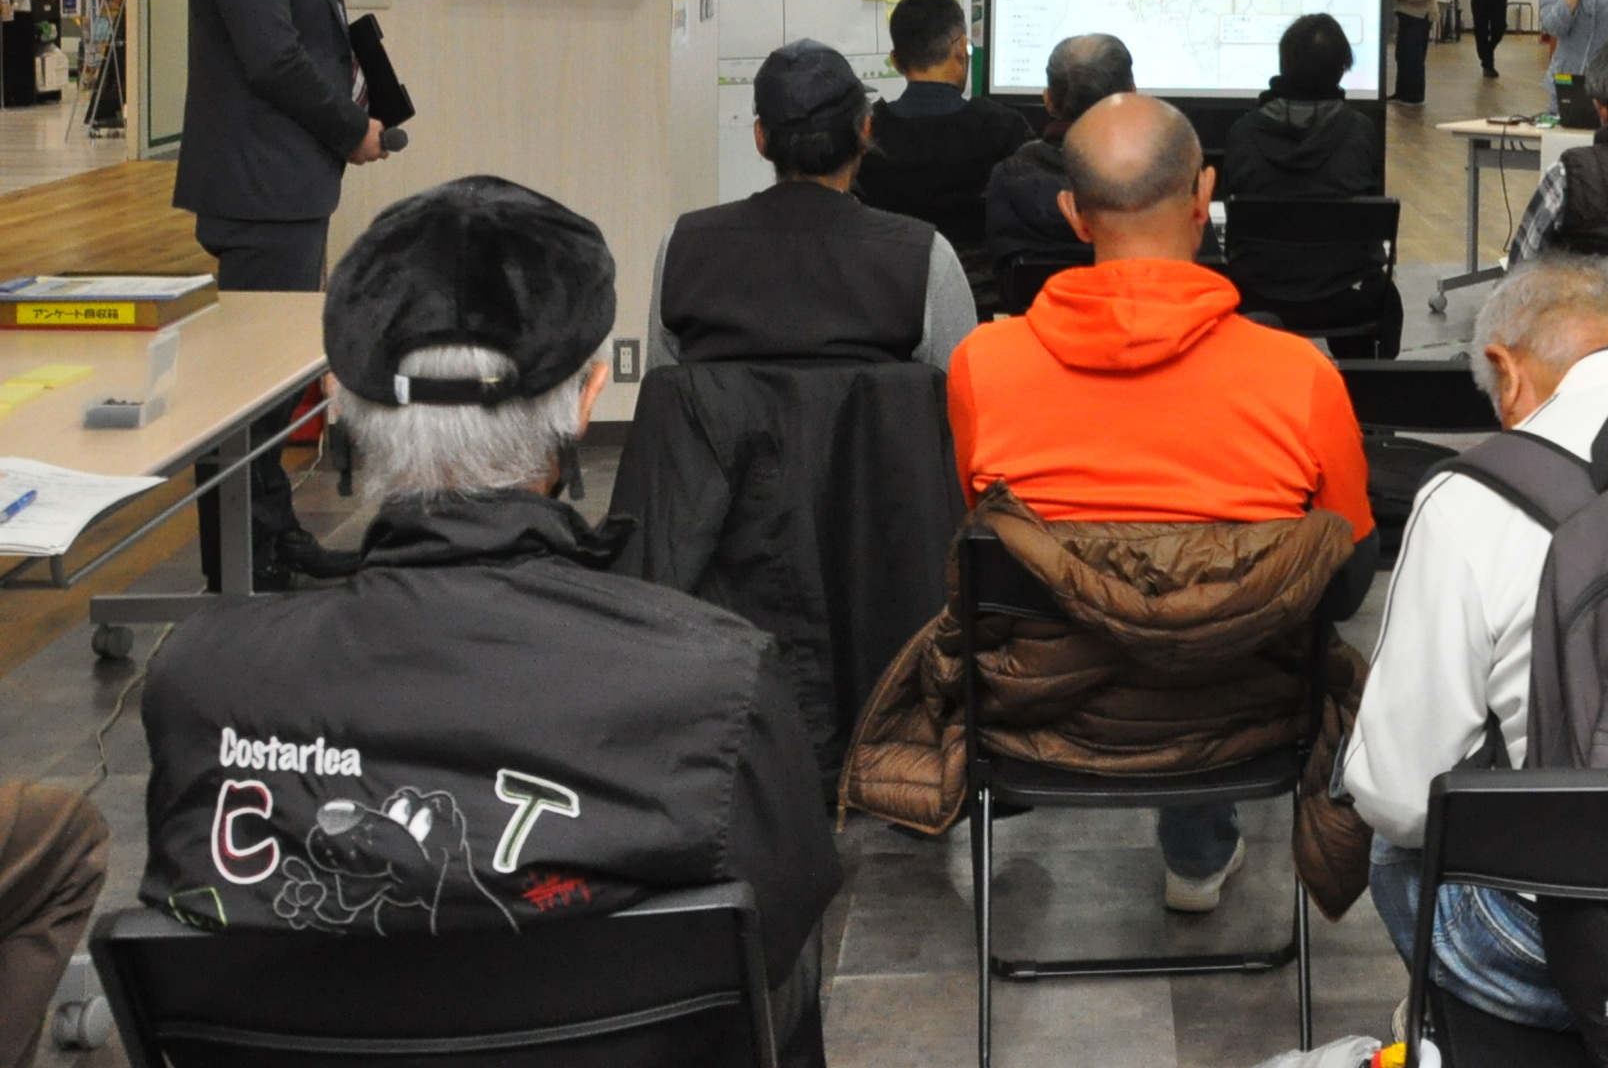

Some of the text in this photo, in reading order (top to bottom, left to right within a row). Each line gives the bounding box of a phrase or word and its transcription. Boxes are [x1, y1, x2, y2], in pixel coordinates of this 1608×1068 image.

[32, 308, 119, 321] アンケート回収箱
[220, 727, 362, 777] Costarica
